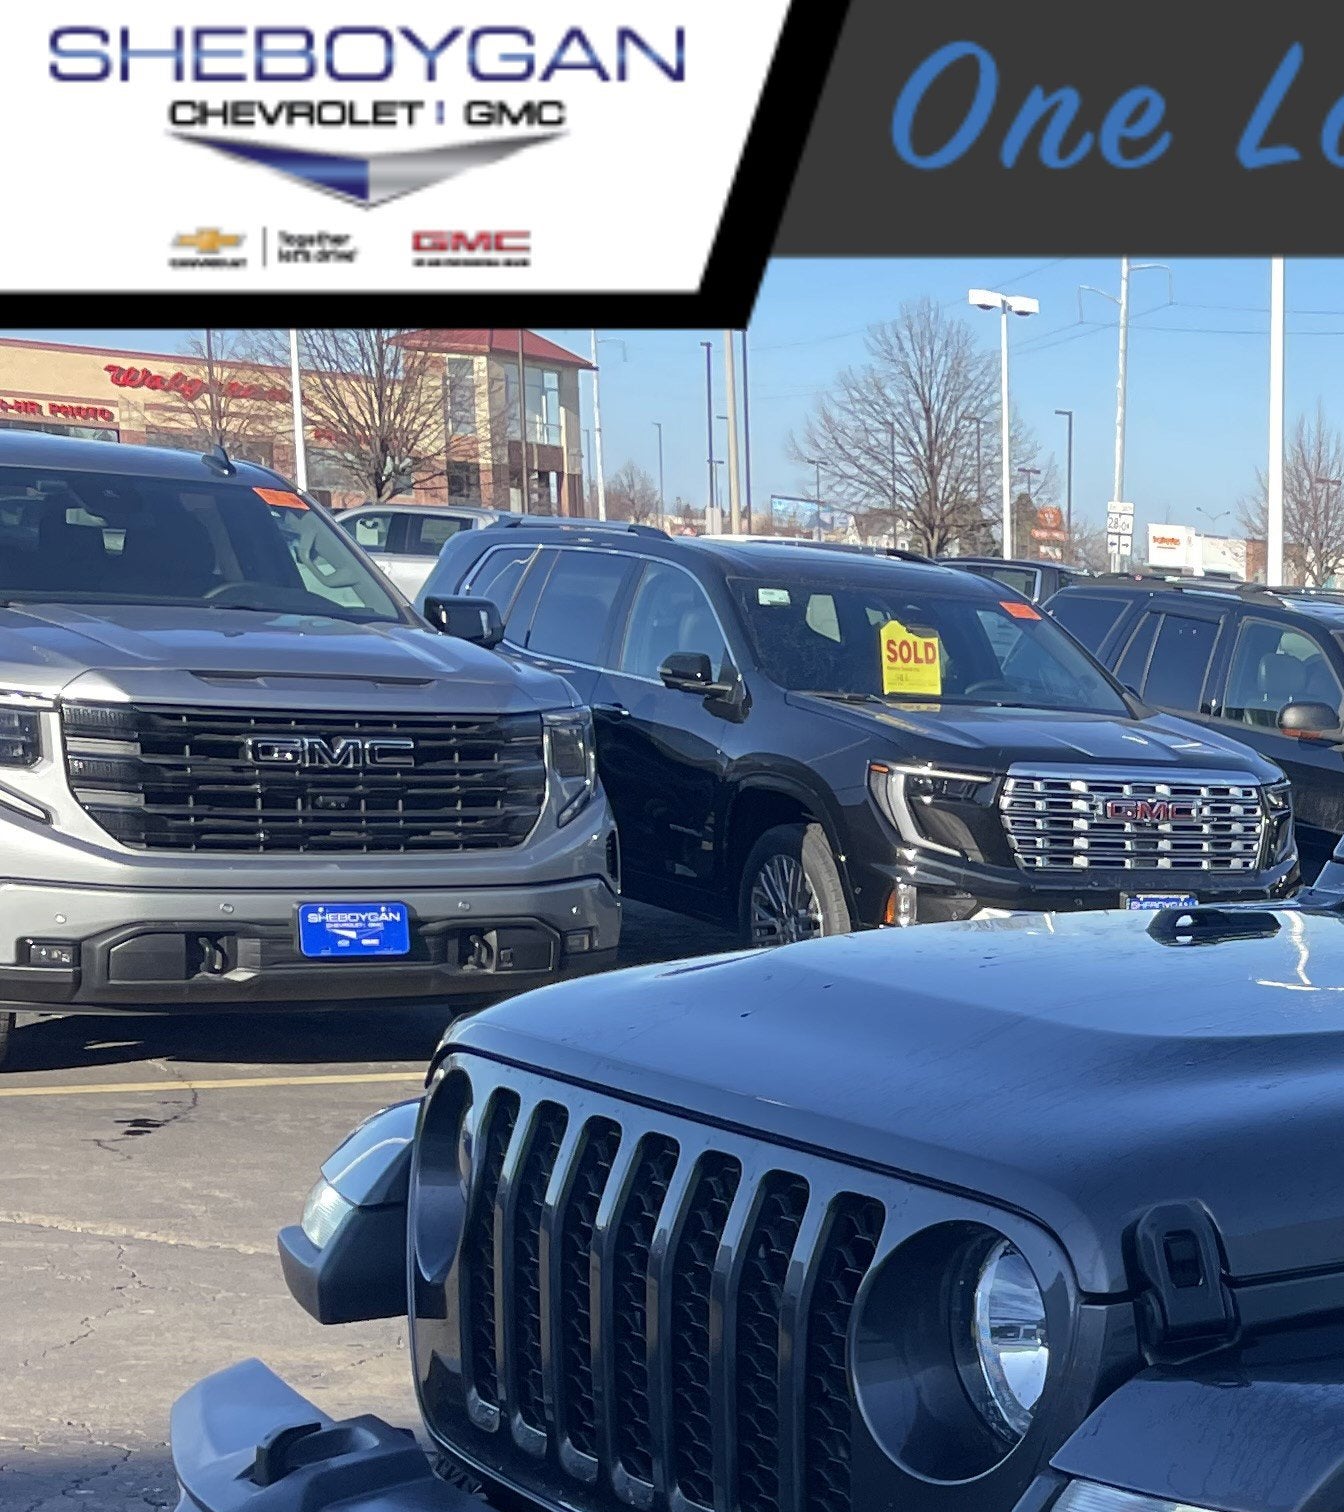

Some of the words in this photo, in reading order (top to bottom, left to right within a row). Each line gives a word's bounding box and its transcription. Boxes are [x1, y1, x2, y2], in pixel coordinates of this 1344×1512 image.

[886, 639, 937, 664] SOLD
[246, 737, 415, 769] GMC
[1107, 800, 1198, 823] GMC
[307, 911, 400, 923] SHEBOYGAN
